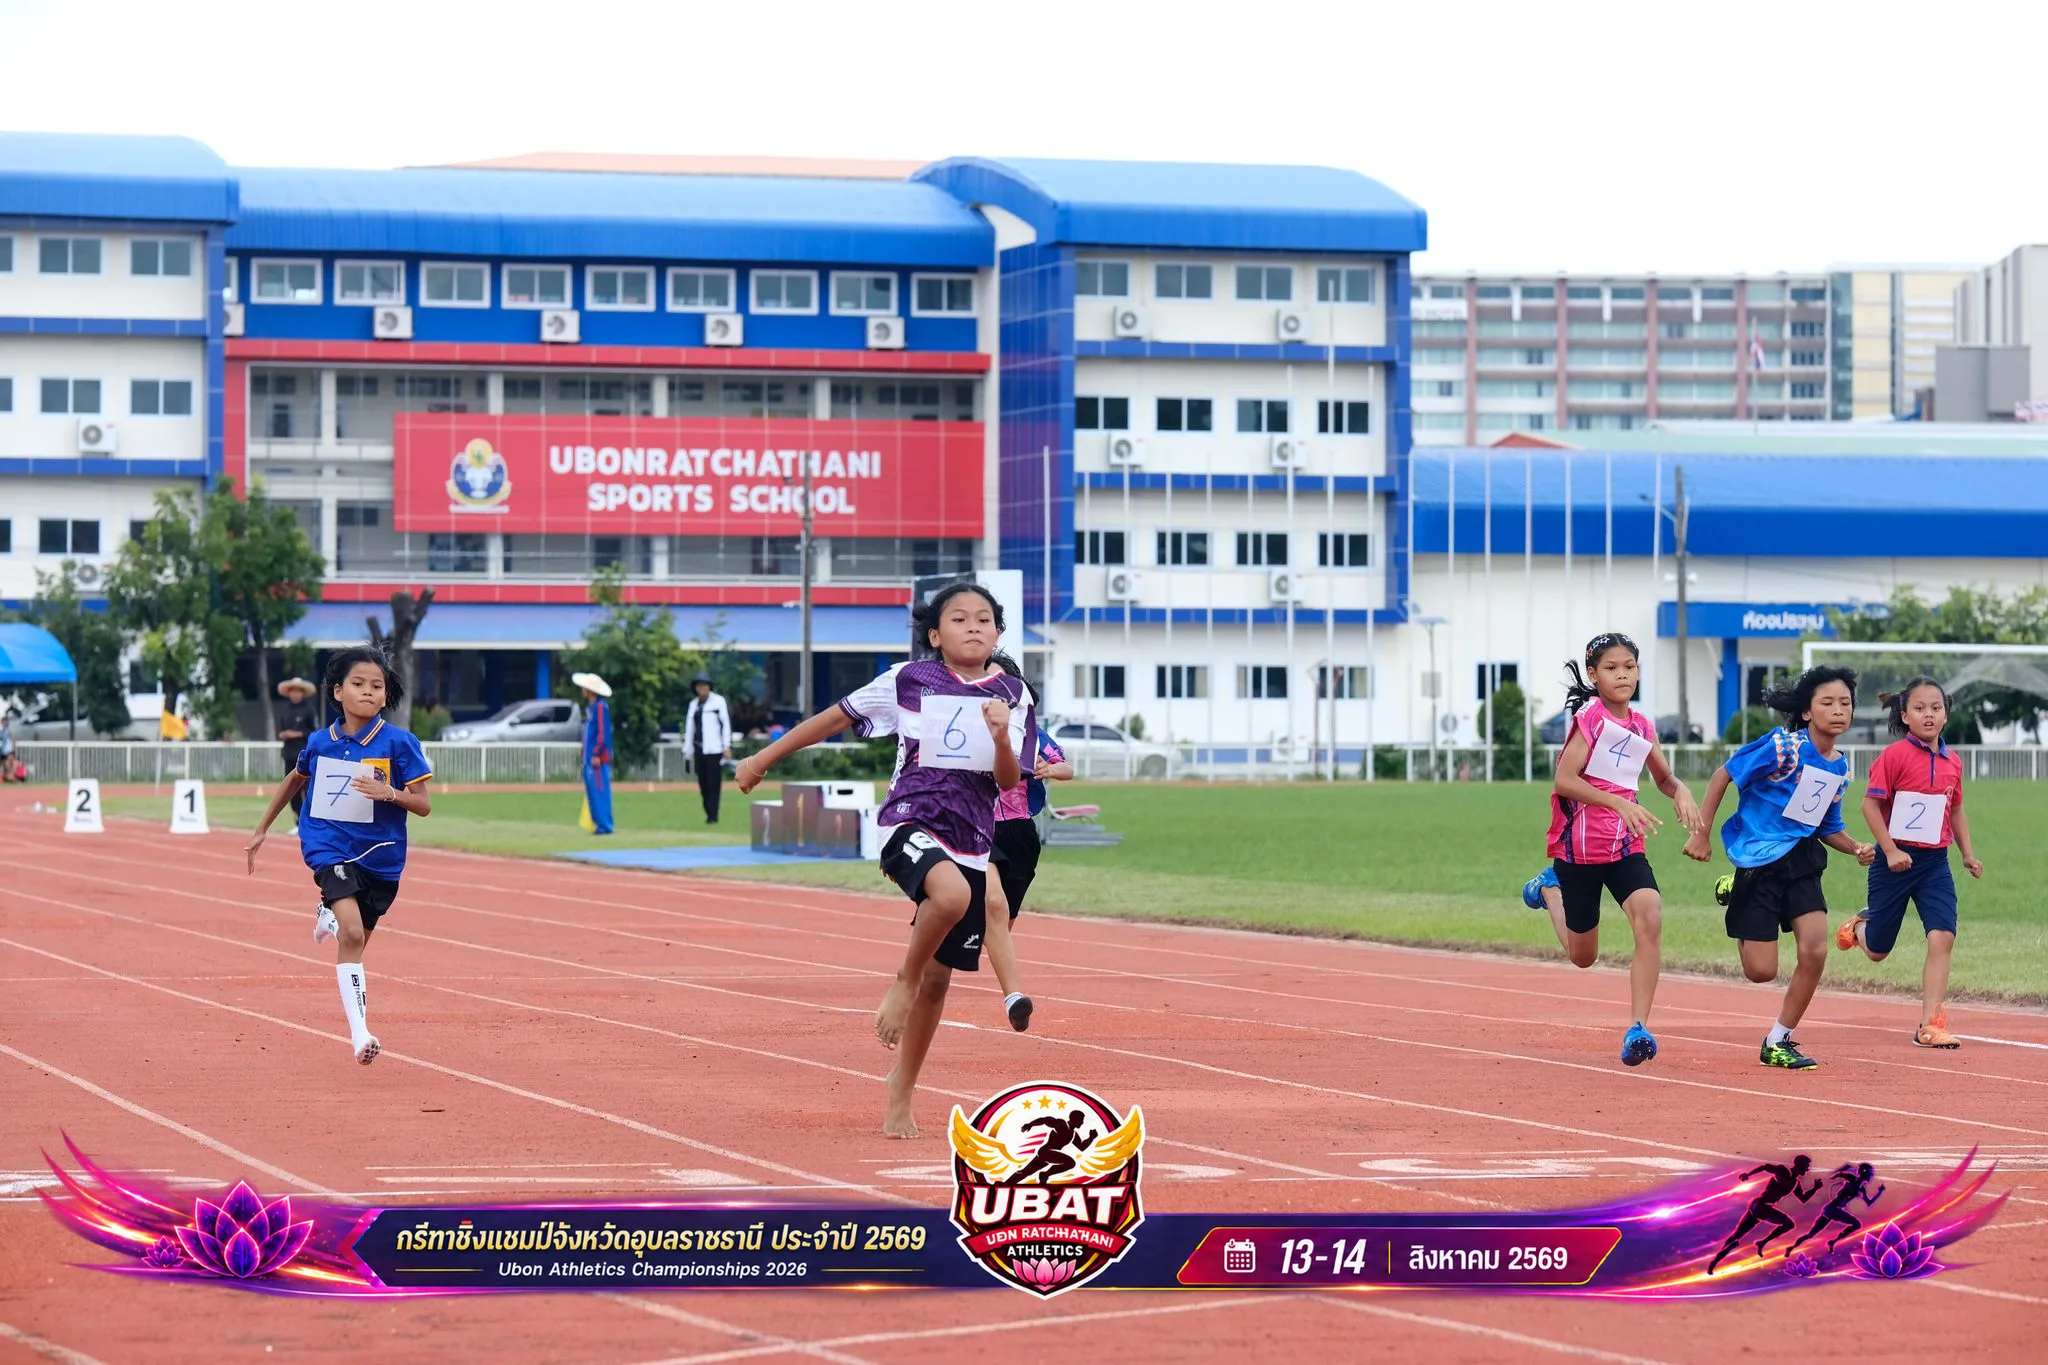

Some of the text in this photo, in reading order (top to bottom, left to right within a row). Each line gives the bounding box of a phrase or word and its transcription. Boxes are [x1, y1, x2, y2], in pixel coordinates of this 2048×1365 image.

[550, 446, 881, 478] UBONRATCHATHANI
[588, 483, 856, 514] SPORTS SCHOOL
[943, 707, 966, 750] 6
[1608, 734, 1631, 767] 4
[76, 789, 91, 813] 2
[184, 789, 195, 813] 1
[326, 774, 351, 806] 7
[1802, 780, 1827, 813] 3
[1905, 802, 1926, 830] 2
